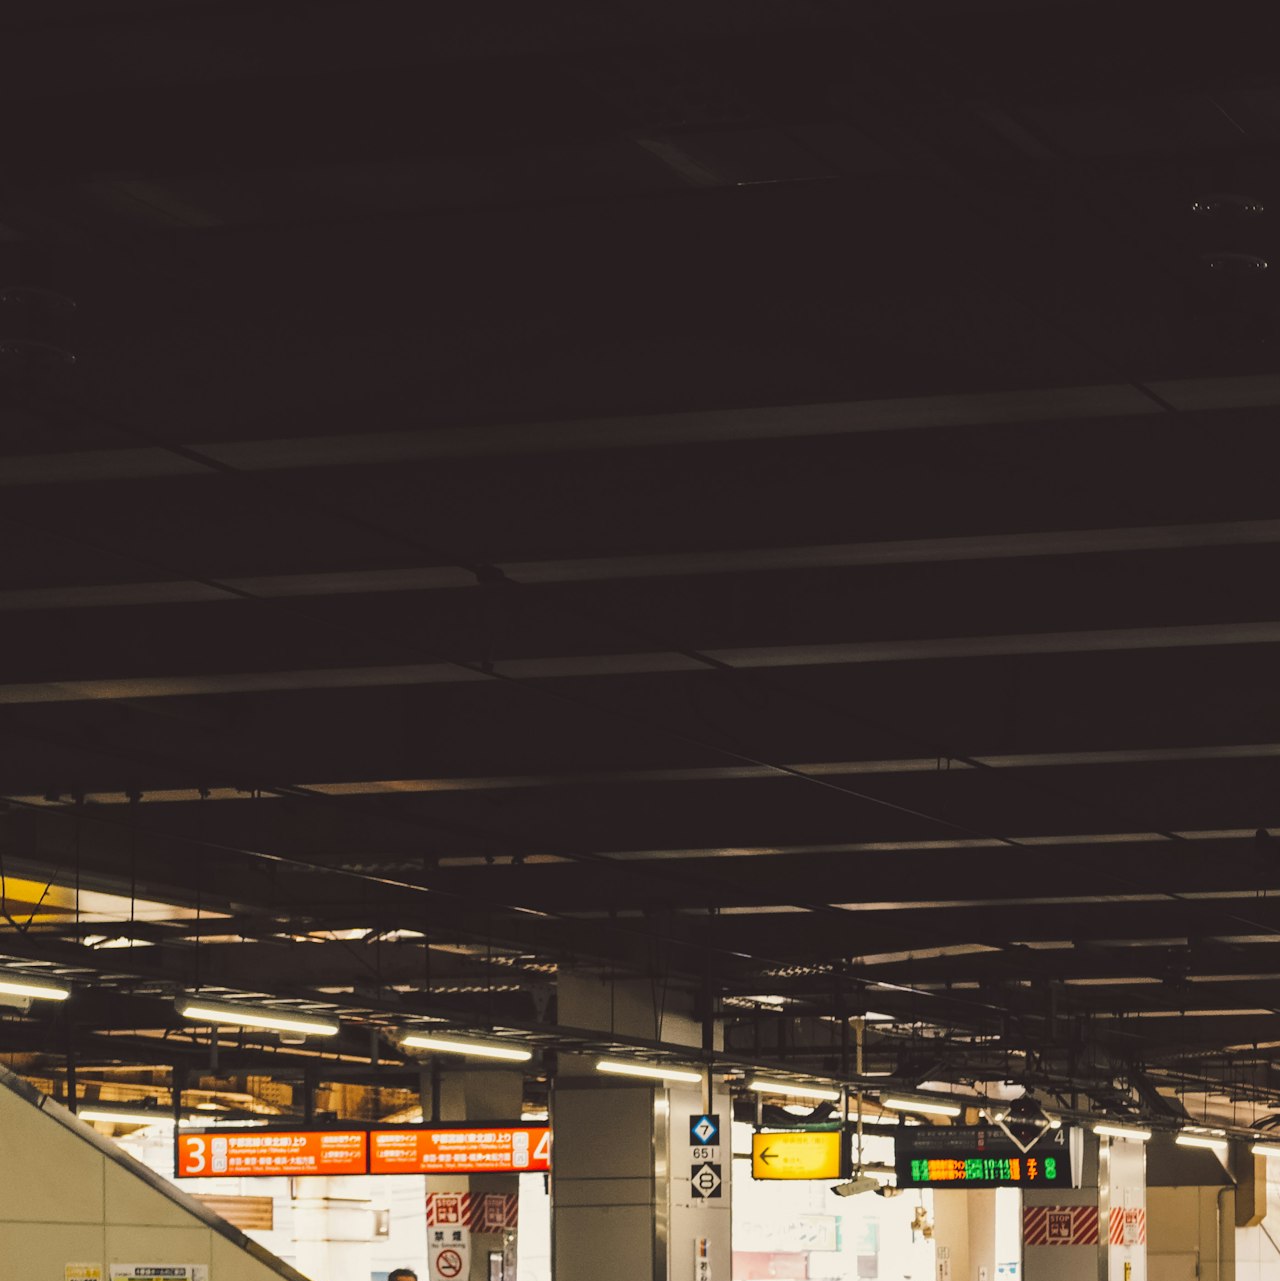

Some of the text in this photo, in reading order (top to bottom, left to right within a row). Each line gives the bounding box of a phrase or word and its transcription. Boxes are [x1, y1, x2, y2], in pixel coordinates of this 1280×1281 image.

[700, 1125, 709, 1136] 7
[1054, 1129, 1065, 1146] 4
[186, 1137, 206, 1173] 3
[533, 1131, 550, 1166] 4
